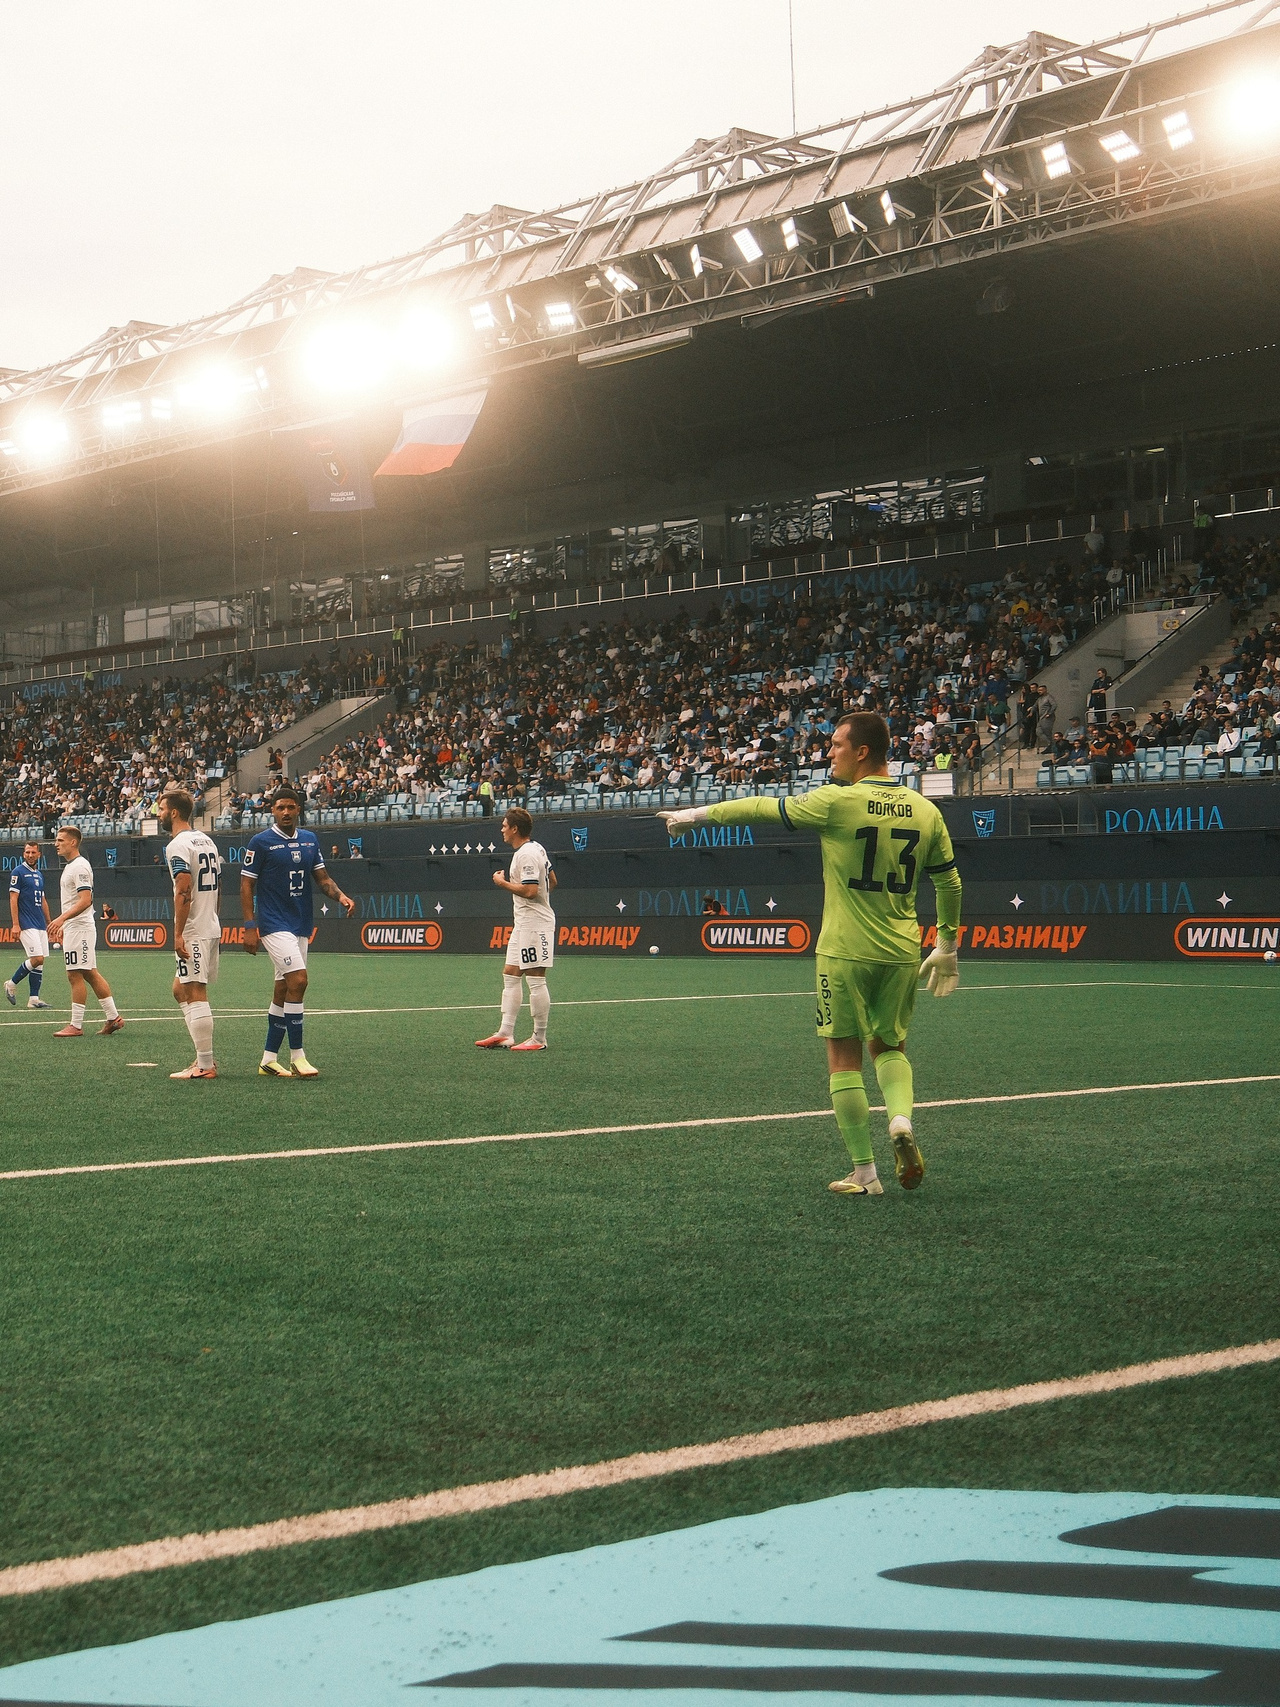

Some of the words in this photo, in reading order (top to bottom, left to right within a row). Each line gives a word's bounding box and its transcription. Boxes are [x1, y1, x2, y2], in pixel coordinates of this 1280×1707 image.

[23, 682, 67, 701] АРЕНА
[867, 800, 913, 818] ВОЛКОВ
[848, 826, 920, 894] 13
[110, 928, 153, 942] WINLINE
[368, 928, 424, 943] WINLINE
[558, 926, 641, 949] РАЗНИЦУ
[709, 927, 787, 945] WINLINE
[971, 925, 1087, 953] РАЗНИЦУ
[1187, 927, 1280, 948] WINLIN
[521, 947, 537, 964] 88
[540, 933, 549, 961] Vorgol
[191, 943, 201, 974] Vorgol
[819, 974, 832, 1025] Vorgol
